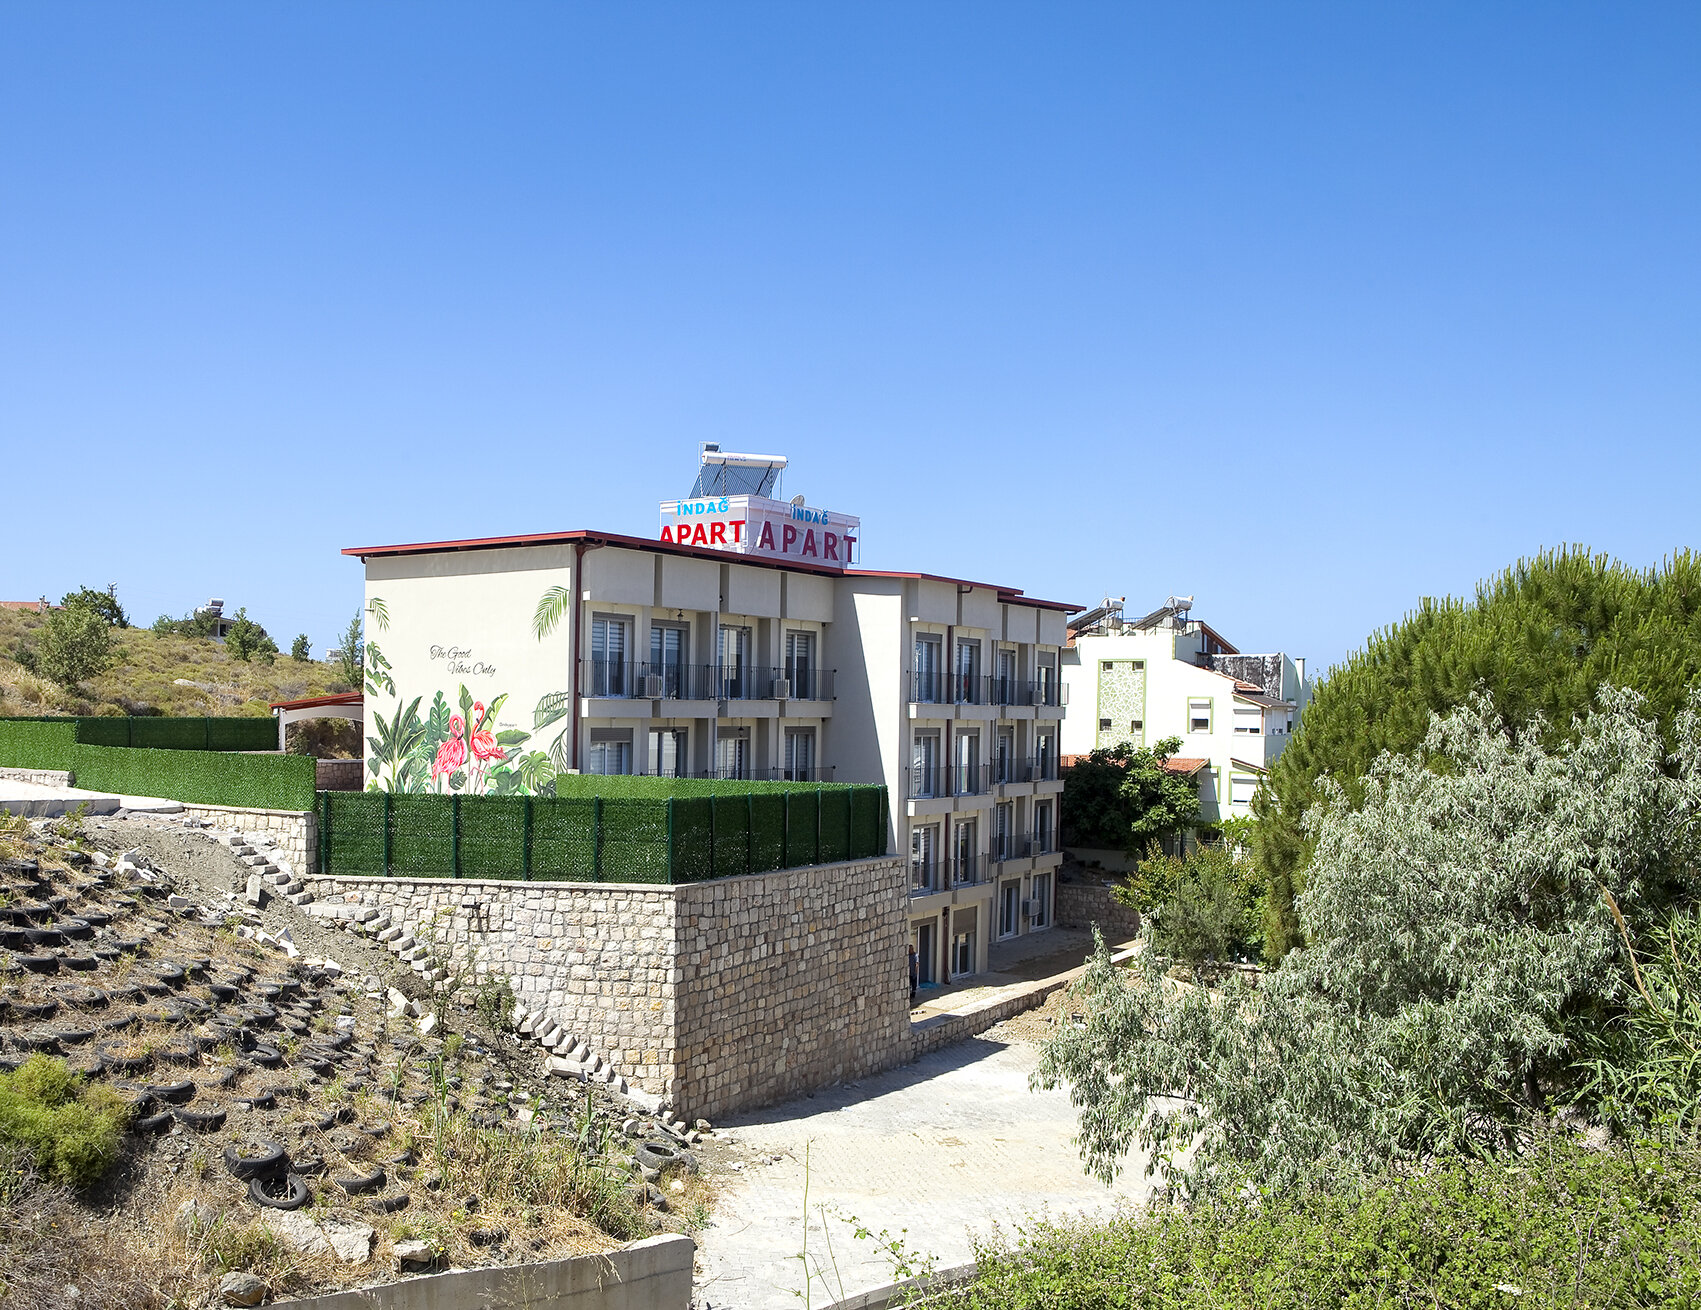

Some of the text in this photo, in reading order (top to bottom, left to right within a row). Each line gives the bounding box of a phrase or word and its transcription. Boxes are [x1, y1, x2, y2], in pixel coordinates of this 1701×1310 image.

[677, 497, 729, 516] İNDAĞ
[791, 503, 829, 526] İNDAĞ
[660, 520, 746, 546] APART
[758, 521, 857, 563] APART
[430, 645, 472, 661] The Good
[447, 661, 497, 678] Vibes Only
